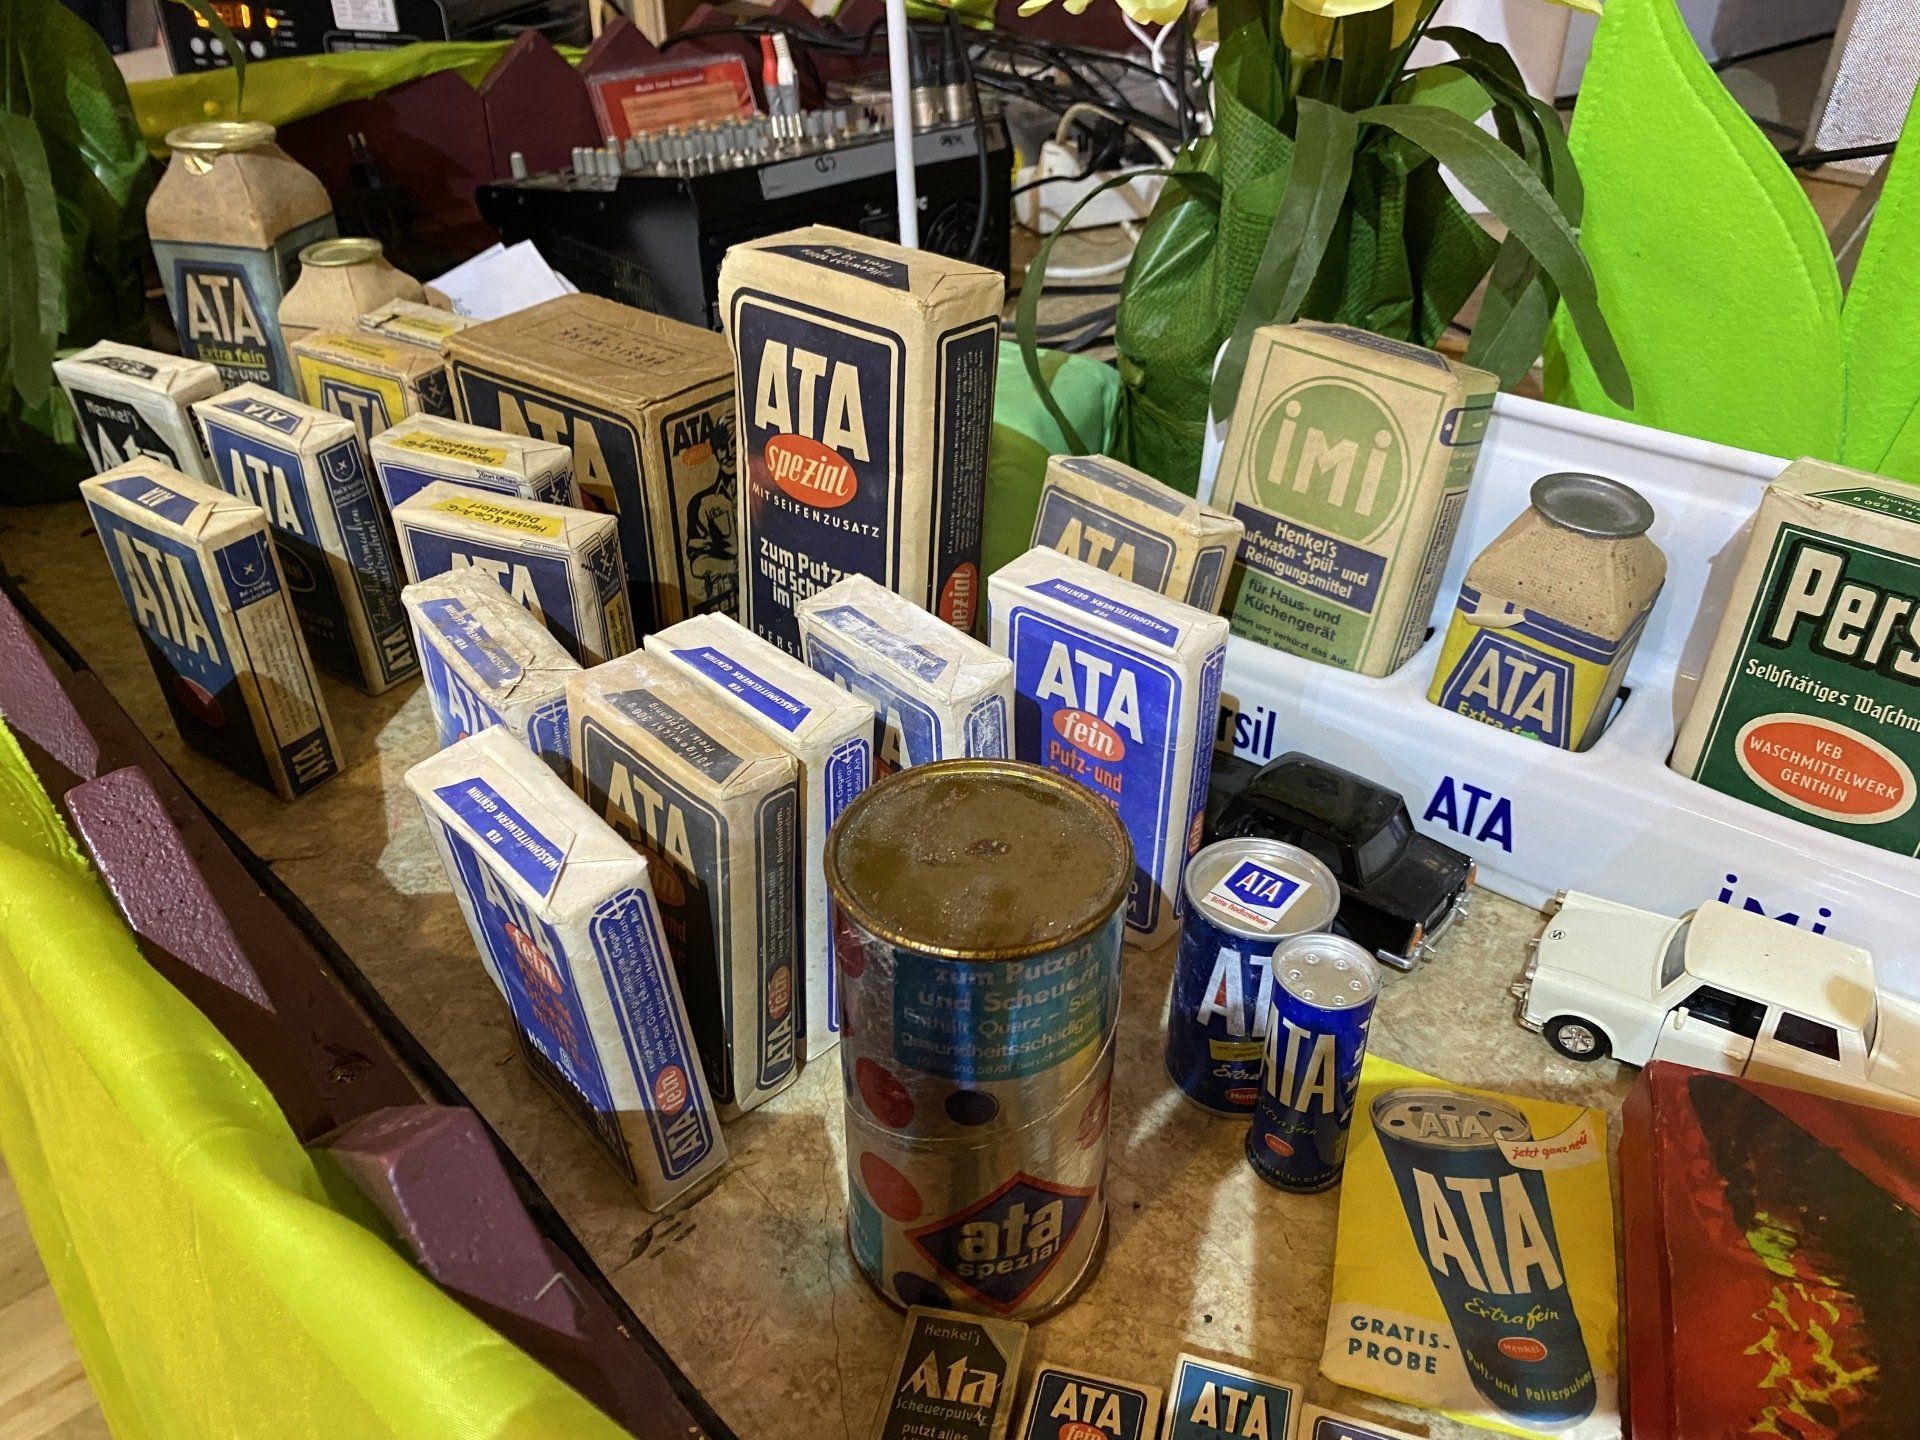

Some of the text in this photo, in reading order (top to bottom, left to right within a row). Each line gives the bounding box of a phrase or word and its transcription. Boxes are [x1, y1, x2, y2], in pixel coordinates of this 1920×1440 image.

[186, 273, 266, 346] ATA
[197, 344, 265, 365] Extra fein
[218, 366, 271, 382] TZ-UND
[243, 403, 286, 424] ATA
[754, 338, 870, 463] ATA
[426, 438, 489, 455] Düsseldorf
[455, 450, 496, 466] Henkel
[672, 411, 716, 457] ATA
[230, 448, 304, 536] ATA
[767, 444, 850, 497] spezial
[467, 503, 541, 524] Düsseldorf
[502, 517, 549, 533] Henkel
[752, 482, 881, 538] MIT SEIFENZUSATZ
[760, 536, 855, 585] zum Putz
[1241, 530, 1369, 587] ufwasch- Spül- und
[1274, 520, 1338, 560] Henkel's
[760, 557, 787, 586] und
[773, 582, 790, 609] im
[1053, 583, 1090, 601] GENTHIN
[1244, 548, 1353, 600] Reinigungsmittel
[112, 527, 222, 667] ATA
[948, 570, 971, 631] ezial
[1091, 595, 1170, 634] WASCHMITTELWERK
[1093, 608, 1109, 619] VEB
[1243, 592, 1337, 643] Küchengerät
[1248, 577, 1267, 596] für
[1269, 579, 1312, 614] Haus-
[1313, 603, 1341, 626] und
[383, 624, 414, 673] ATA
[1254, 621, 1271, 634] und
[1273, 629, 1309, 650] verkürzt
[1310, 644, 1328, 659] das
[1329, 652, 1350, 667] Auf-
[701, 651, 800, 717] WASCHMITTELWERK GENTHIN
[728, 682, 744, 694] VEB
[1035, 640, 1144, 745] ATA
[1459, 647, 1557, 735] ATA
[635, 707, 715, 768] Füllgewicht 300
[689, 732, 716, 754] Preis:
[1064, 711, 1115, 758] fein
[1217, 705, 1277, 760] rsil
[1815, 738, 1843, 760] VEB
[291, 739, 330, 783] ATA
[835, 766, 845, 800] Gegen-
[1050, 741, 1092, 775] Putz-
[1094, 767, 1122, 793] und
[1749, 736, 1900, 801] WASCHMITTELWERK
[1780, 767, 1849, 803] GENTHIN
[466, 786, 560, 872] WASCHMITTELWERK GENTHIN
[485, 829, 503, 846] VEB
[605, 760, 700, 890] ATA
[775, 806, 784, 865] Aluminium.
[1422, 775, 1513, 854] ATA
[1210, 894, 1269, 927] Bitte hochziehen
[1235, 869, 1284, 903] ATA
[512, 928, 559, 986] fein
[604, 923, 625, 958] Gegen-
[615, 915, 641, 965] Porzellan,
[1004, 941, 1094, 985] Putzen
[620, 973, 641, 1009] gründlich
[769, 968, 791, 1014] fein
[983, 960, 1100, 1014] Scheuern
[1197, 947, 1273, 1038] AT
[767, 1011, 794, 1073] ATA
[976, 1013, 1042, 1040] Quarz
[1262, 1001, 1337, 1115] ATA
[659, 1068, 685, 1118] fein
[663, 1105, 703, 1167] ATA
[1419, 1112, 1491, 1139] ATA
[1511, 1145, 1539, 1161] jetzt
[1541, 1142, 1570, 1158] ganz
[957, 1199, 1064, 1262] ata
[1412, 1167, 1563, 1296] ATA
[957, 1236, 1060, 1281] spezial
[1348, 1337, 1438, 1374] PROBE
[1349, 1314, 1451, 1350] GRATIS-
[900, 1350, 1003, 1409] Ata
[1466, 1349, 1592, 1401] Putz- und Polierpulver
[902, 1423, 936, 1440] putzt
[1050, 1382, 1121, 1437] ATA
[1189, 1381, 1269, 1439] ATA
